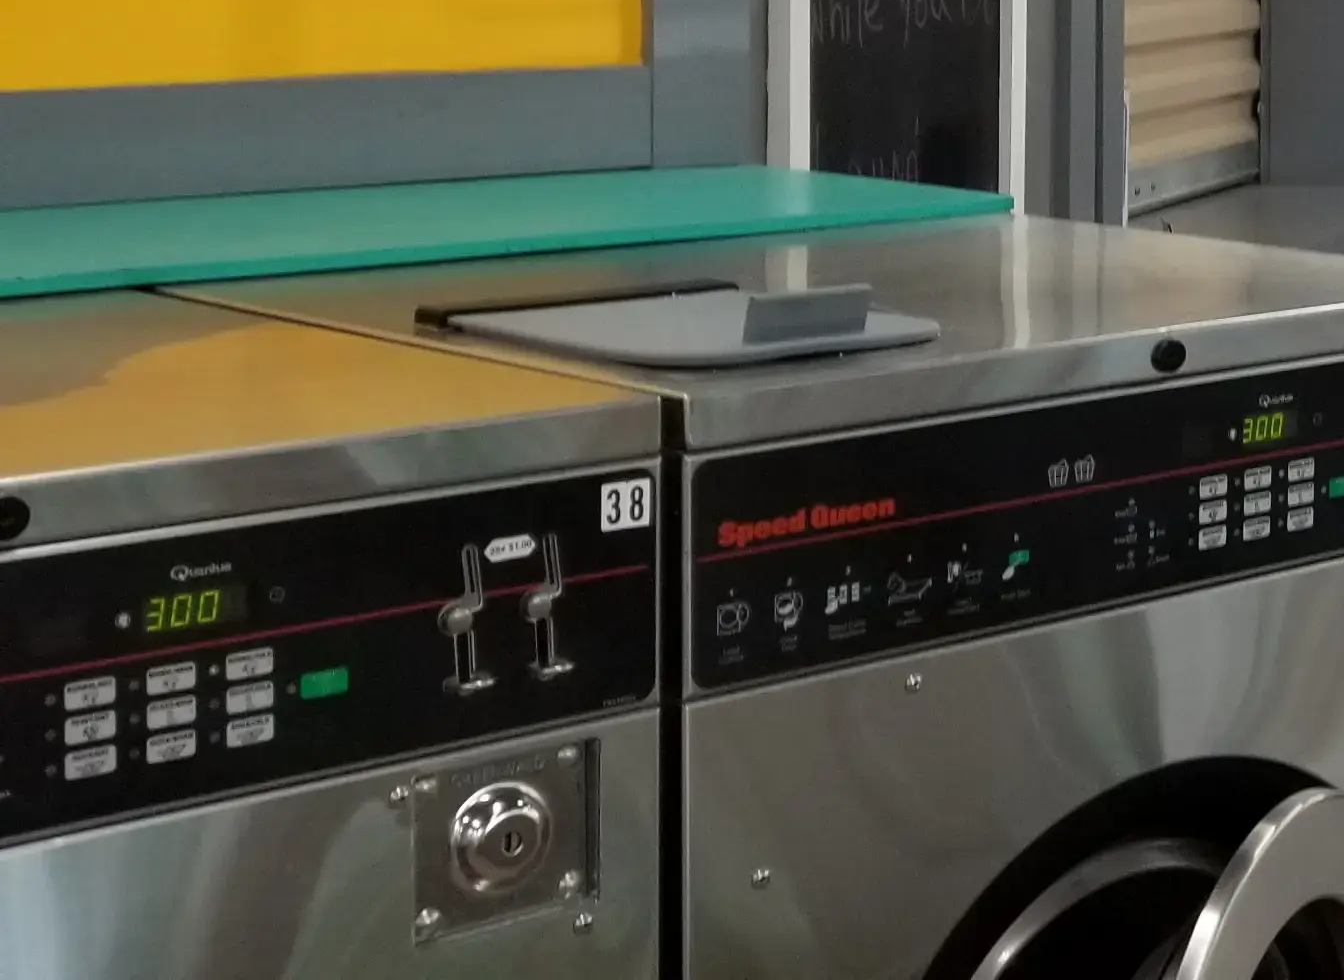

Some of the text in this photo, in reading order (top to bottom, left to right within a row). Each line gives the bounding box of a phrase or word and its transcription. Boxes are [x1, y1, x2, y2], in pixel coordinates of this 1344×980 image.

[1242, 411, 1284, 444] 300
[605, 484, 645, 525] 38
[717, 497, 896, 548] Speed Queen
[146, 588, 220, 633] 300
